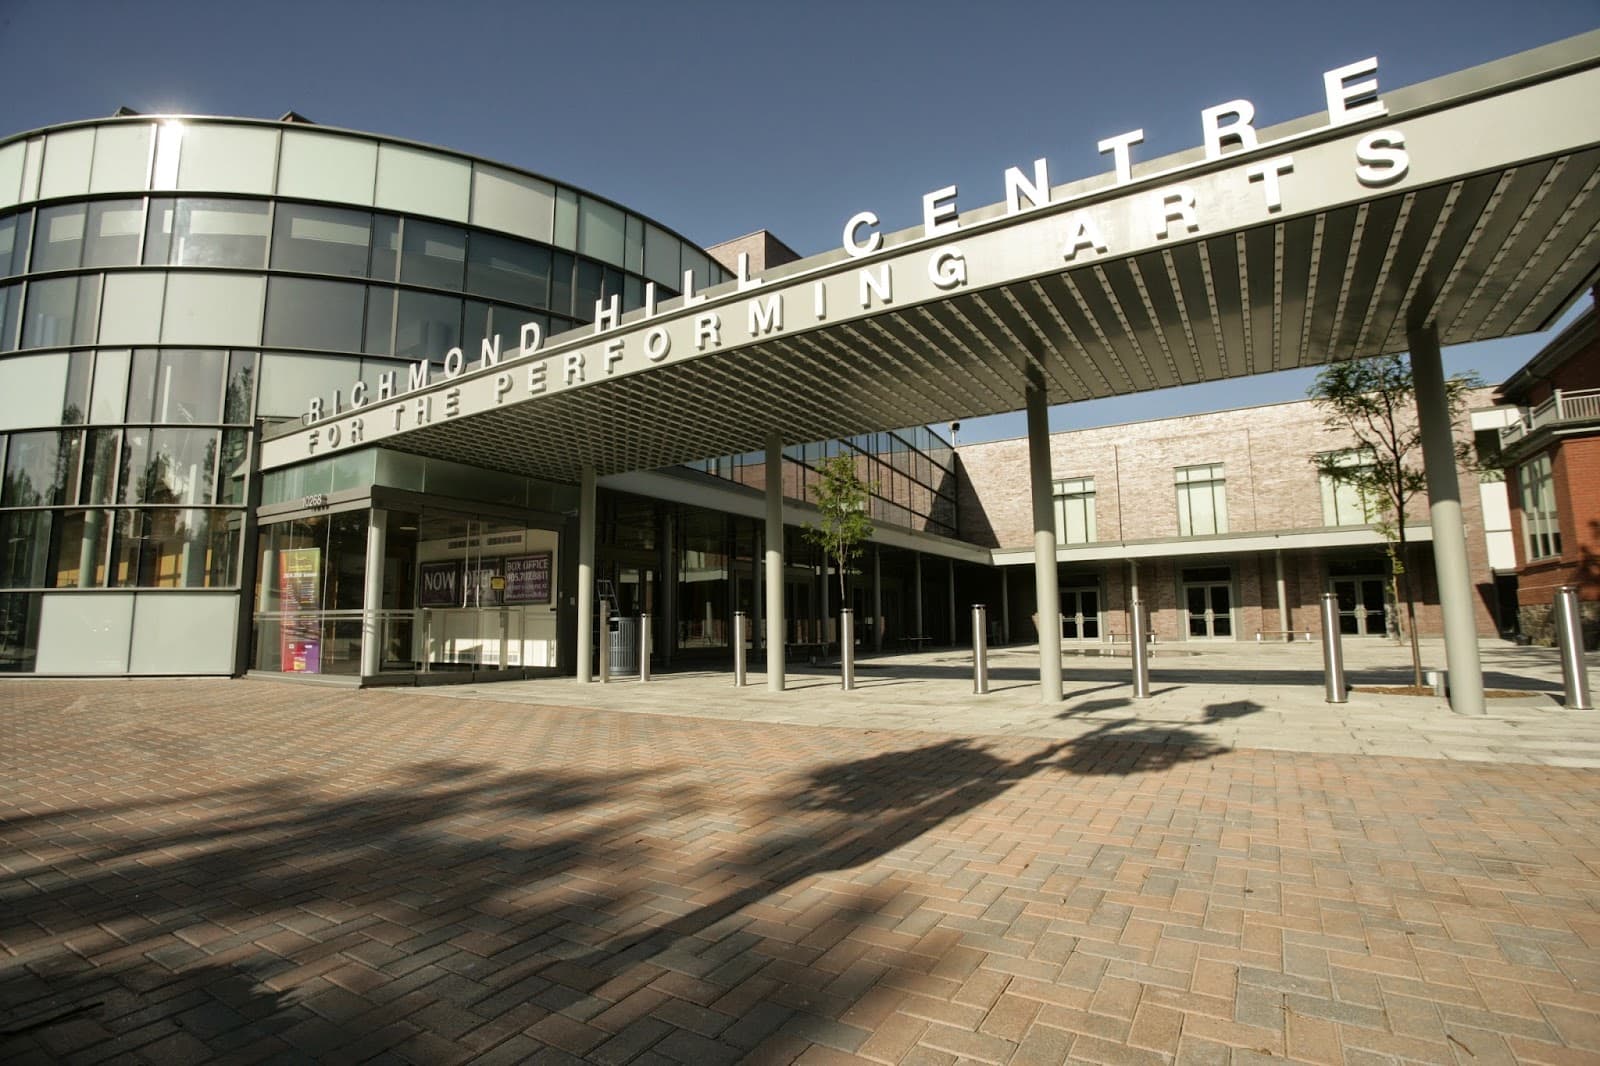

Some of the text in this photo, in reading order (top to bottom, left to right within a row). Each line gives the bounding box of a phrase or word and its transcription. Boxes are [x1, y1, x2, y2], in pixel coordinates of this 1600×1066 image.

[307, 56, 1389, 425] RICHMOND HILL CENTRE
[309, 130, 1410, 454] FOR THE PERFORMING ARTS
[424, 569, 456, 592] NOW
[523, 559, 548, 569] OFFICE
